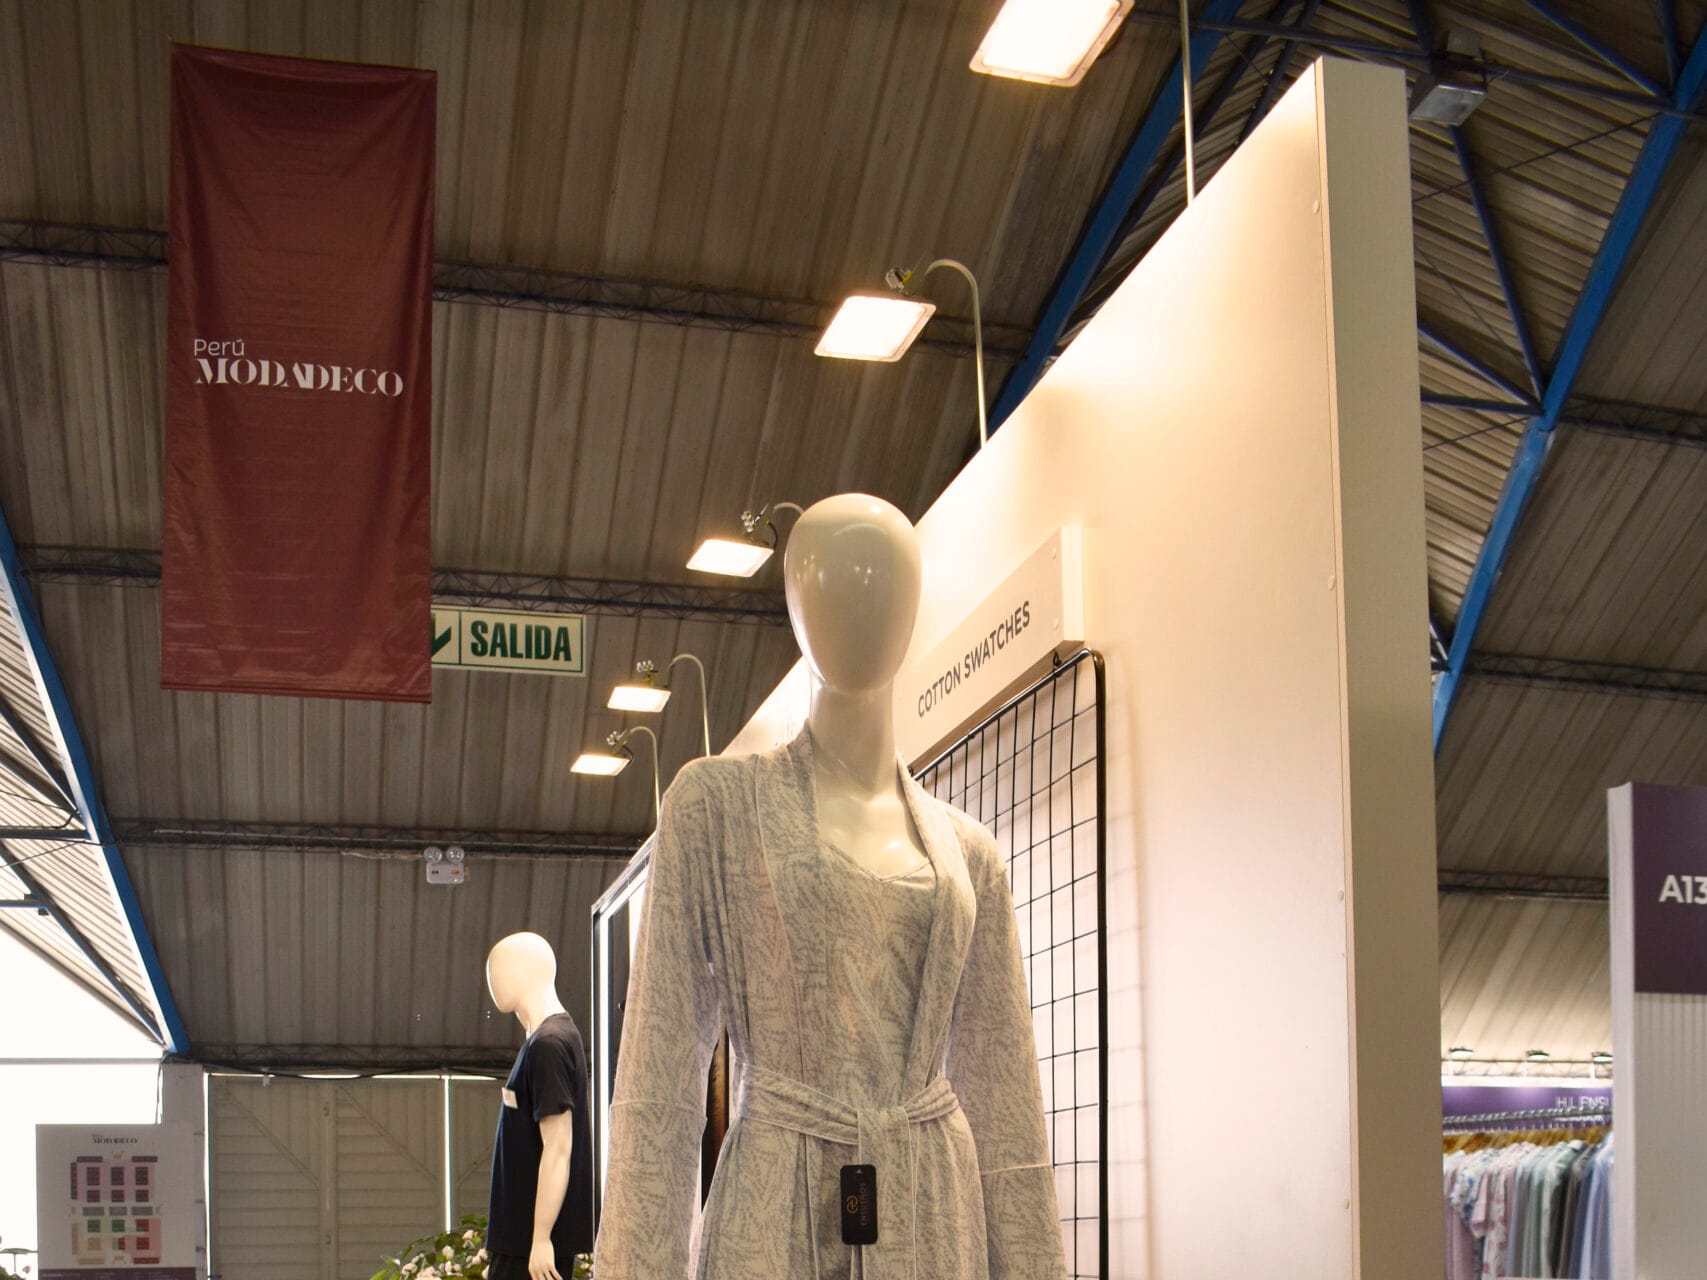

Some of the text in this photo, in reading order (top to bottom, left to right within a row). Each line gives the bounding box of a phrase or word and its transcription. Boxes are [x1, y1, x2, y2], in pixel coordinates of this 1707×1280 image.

[194, 338, 245, 357] Perú
[194, 357, 404, 398] MODADECO
[470, 618, 572, 662] SALIDA
[918, 600, 1031, 718] COTTON SWATCHES
